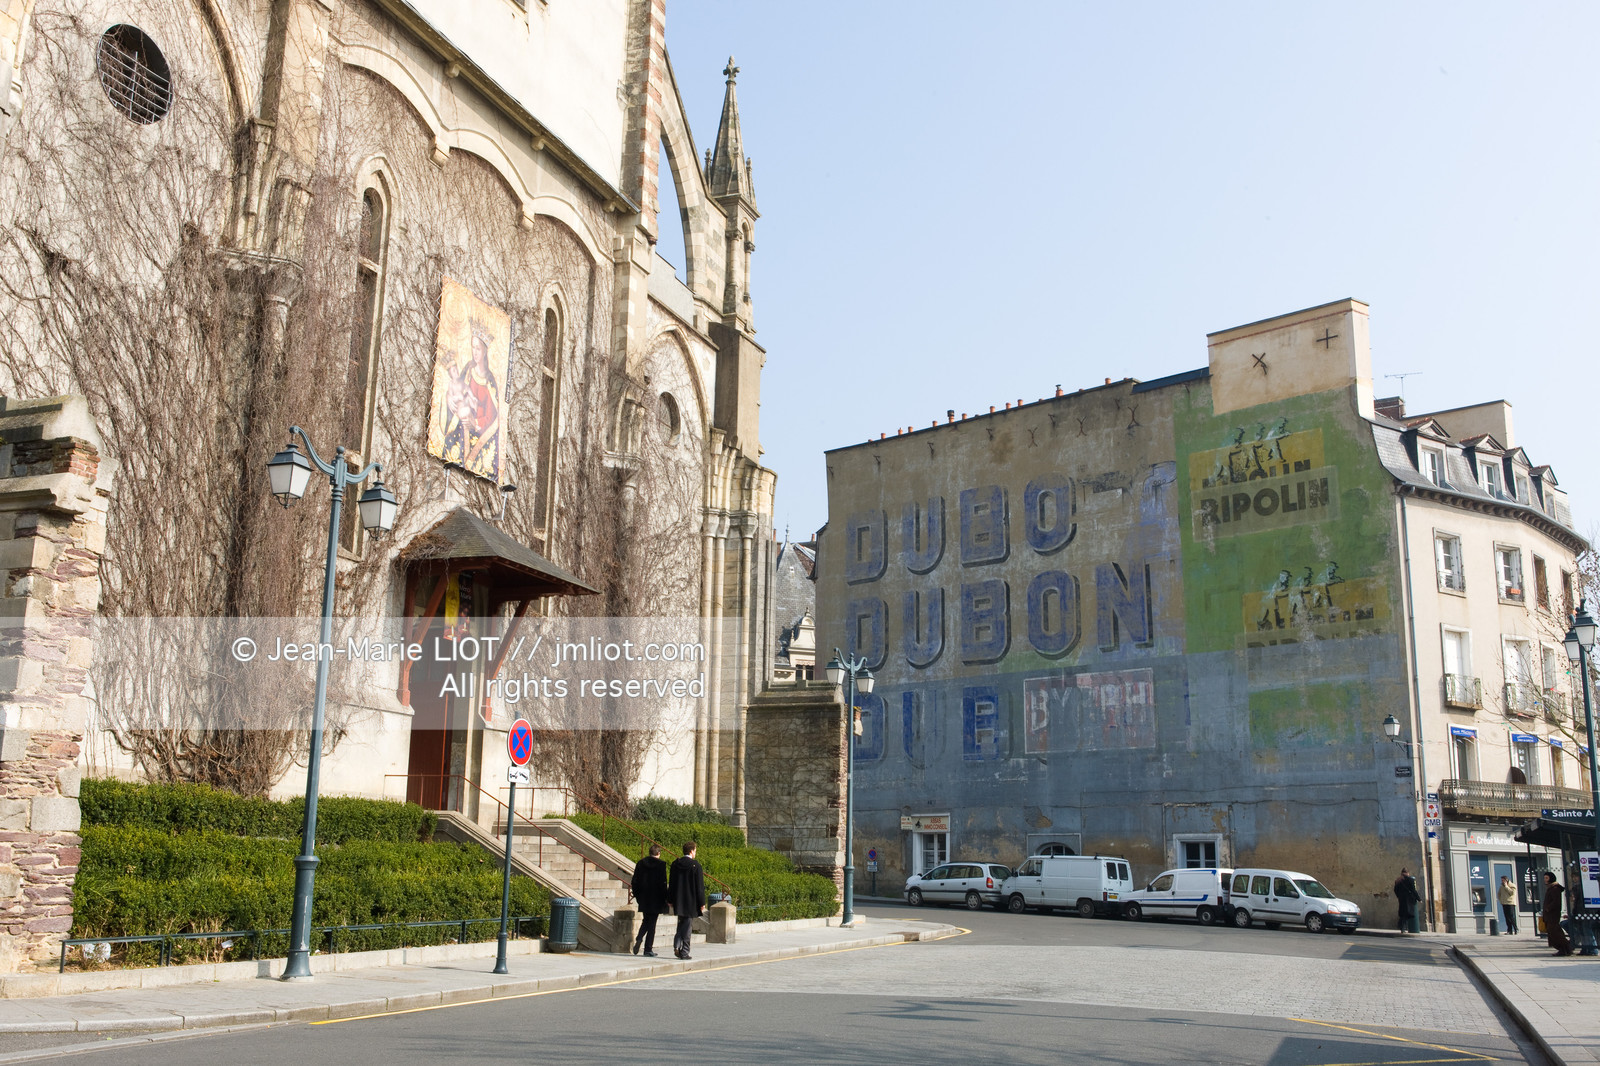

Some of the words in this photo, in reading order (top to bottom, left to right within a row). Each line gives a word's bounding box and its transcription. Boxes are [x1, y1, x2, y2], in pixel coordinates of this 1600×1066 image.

[845, 473, 1077, 586] DUBO
[1201, 477, 1330, 527] RIPOLIN
[845, 561, 1154, 673] DUBON
[1477, 836, 1493, 845] Crédit
[1494, 837, 1511, 846] Mutuel
